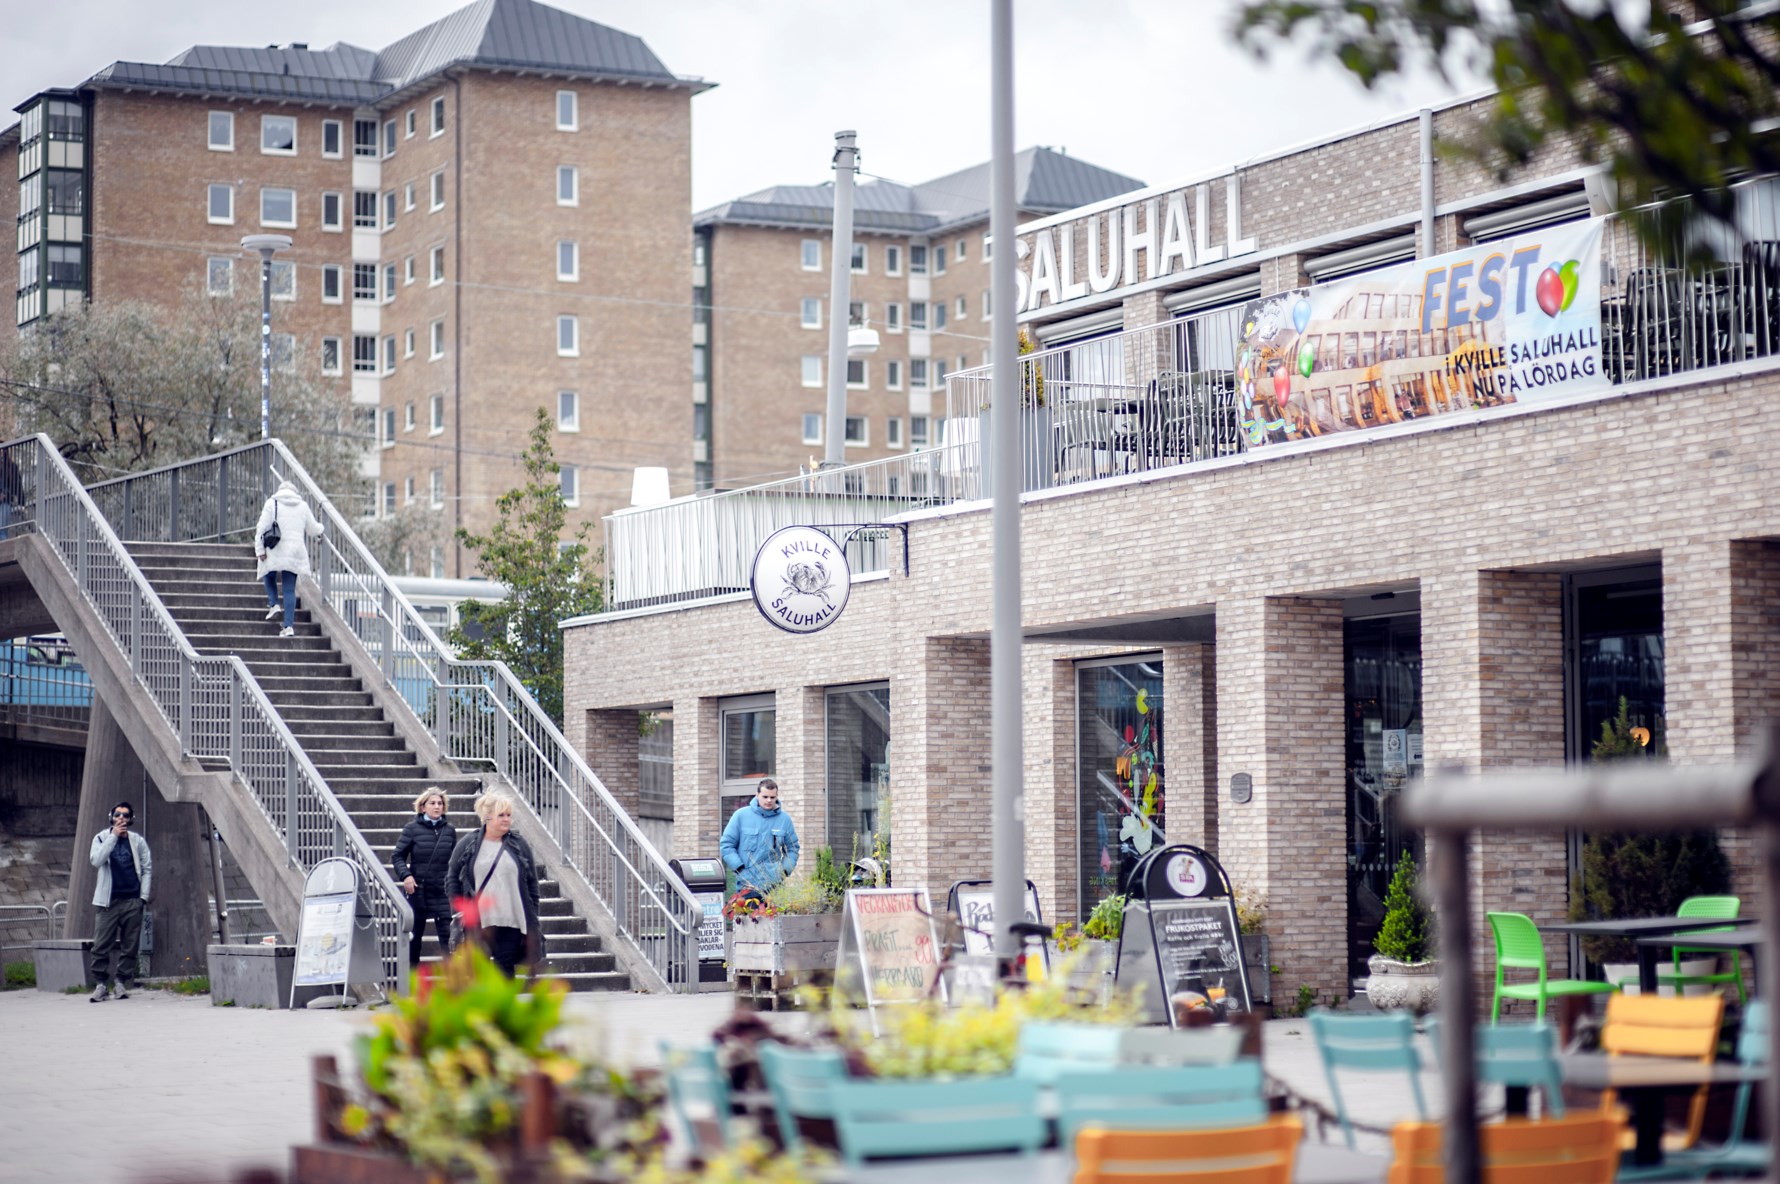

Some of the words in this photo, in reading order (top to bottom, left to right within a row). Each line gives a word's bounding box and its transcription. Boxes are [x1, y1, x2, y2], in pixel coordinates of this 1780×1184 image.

[1419, 244, 1542, 334] FEST
[1454, 346, 1507, 375] KVILLE
[1511, 327, 1598, 364] SALUHALL
[1473, 376, 1494, 398] NU
[1522, 356, 1595, 388] LÖRDAG
[781, 541, 831, 560] KVILLE
[771, 598, 837, 626] SALUHALL
[1165, 922, 1222, 933] FRUKOSTPAKET
